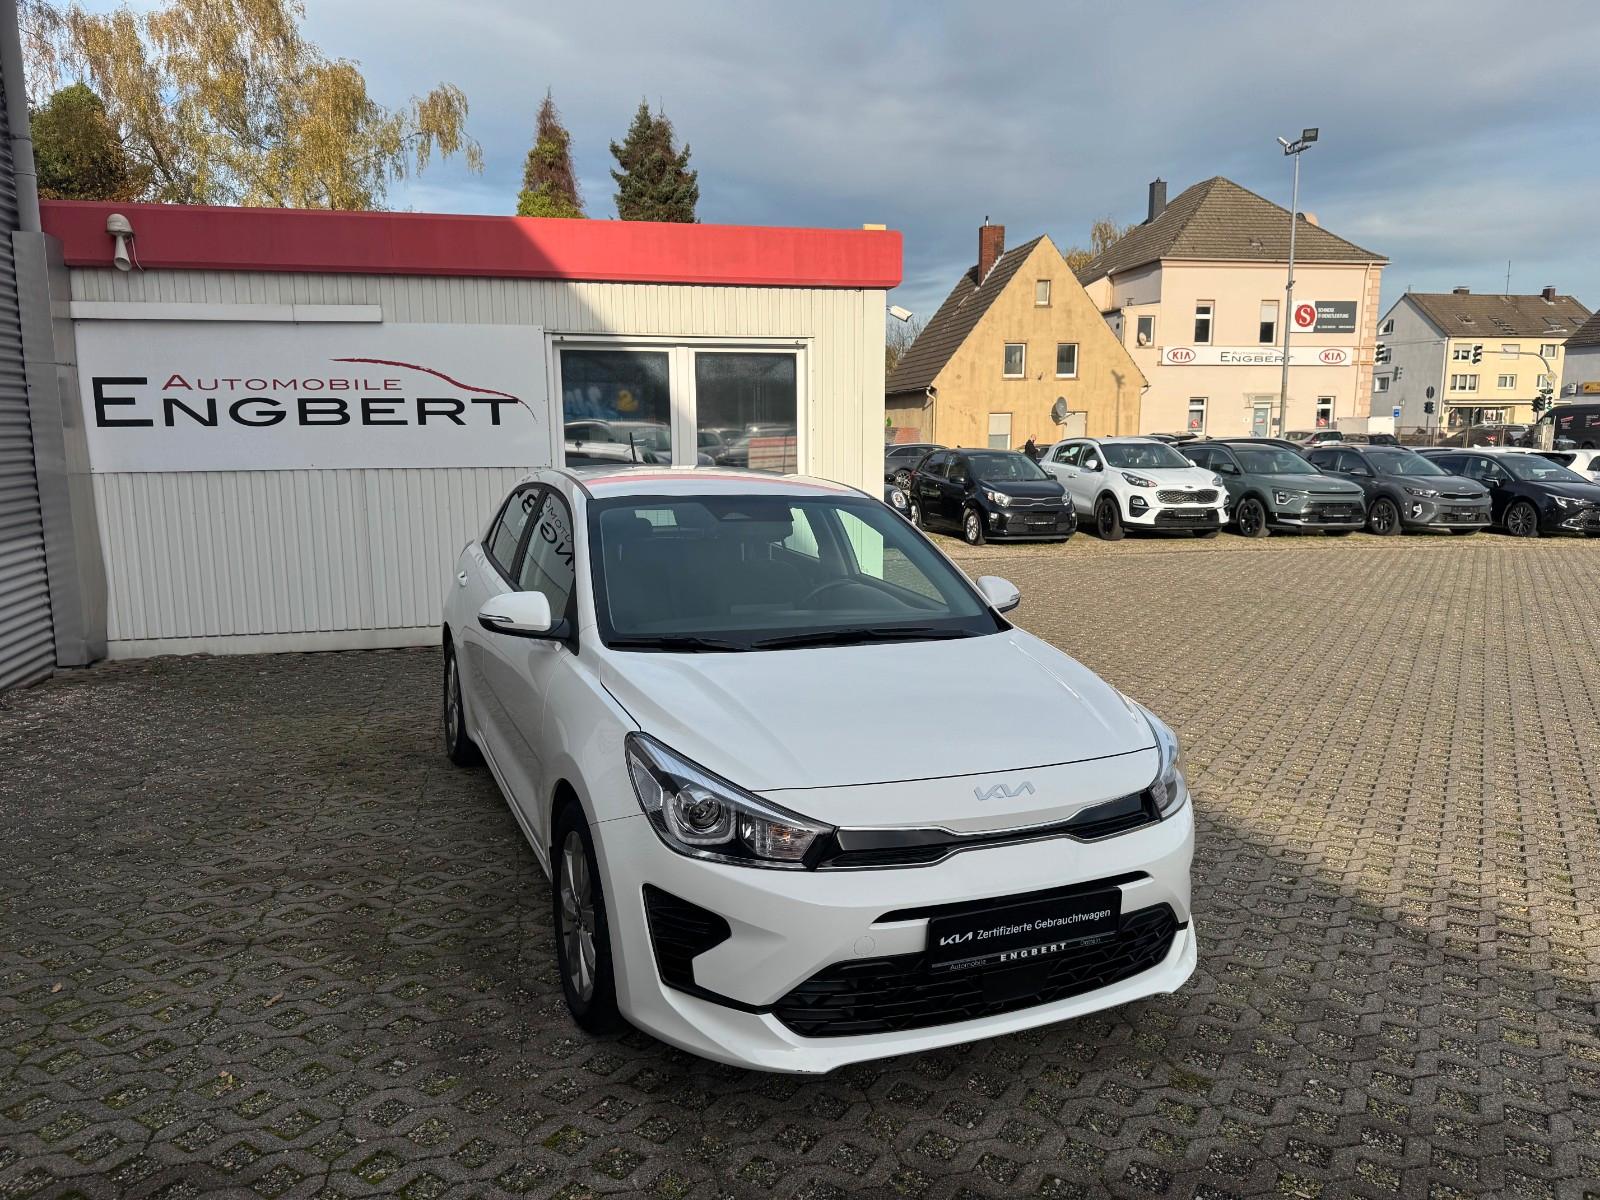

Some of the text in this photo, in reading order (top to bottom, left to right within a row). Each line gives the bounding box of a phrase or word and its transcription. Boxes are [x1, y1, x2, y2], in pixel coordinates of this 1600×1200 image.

[1172, 351, 1191, 360] KIA
[1324, 352, 1342, 361] KIA
[162, 374, 403, 391] AUTOMOBILE
[92, 377, 518, 427] ENGBERT
[940, 908, 1111, 946] KIA Zertifizierte Gebrauchtwagen
[1000, 942, 1067, 962] ENGBERT
